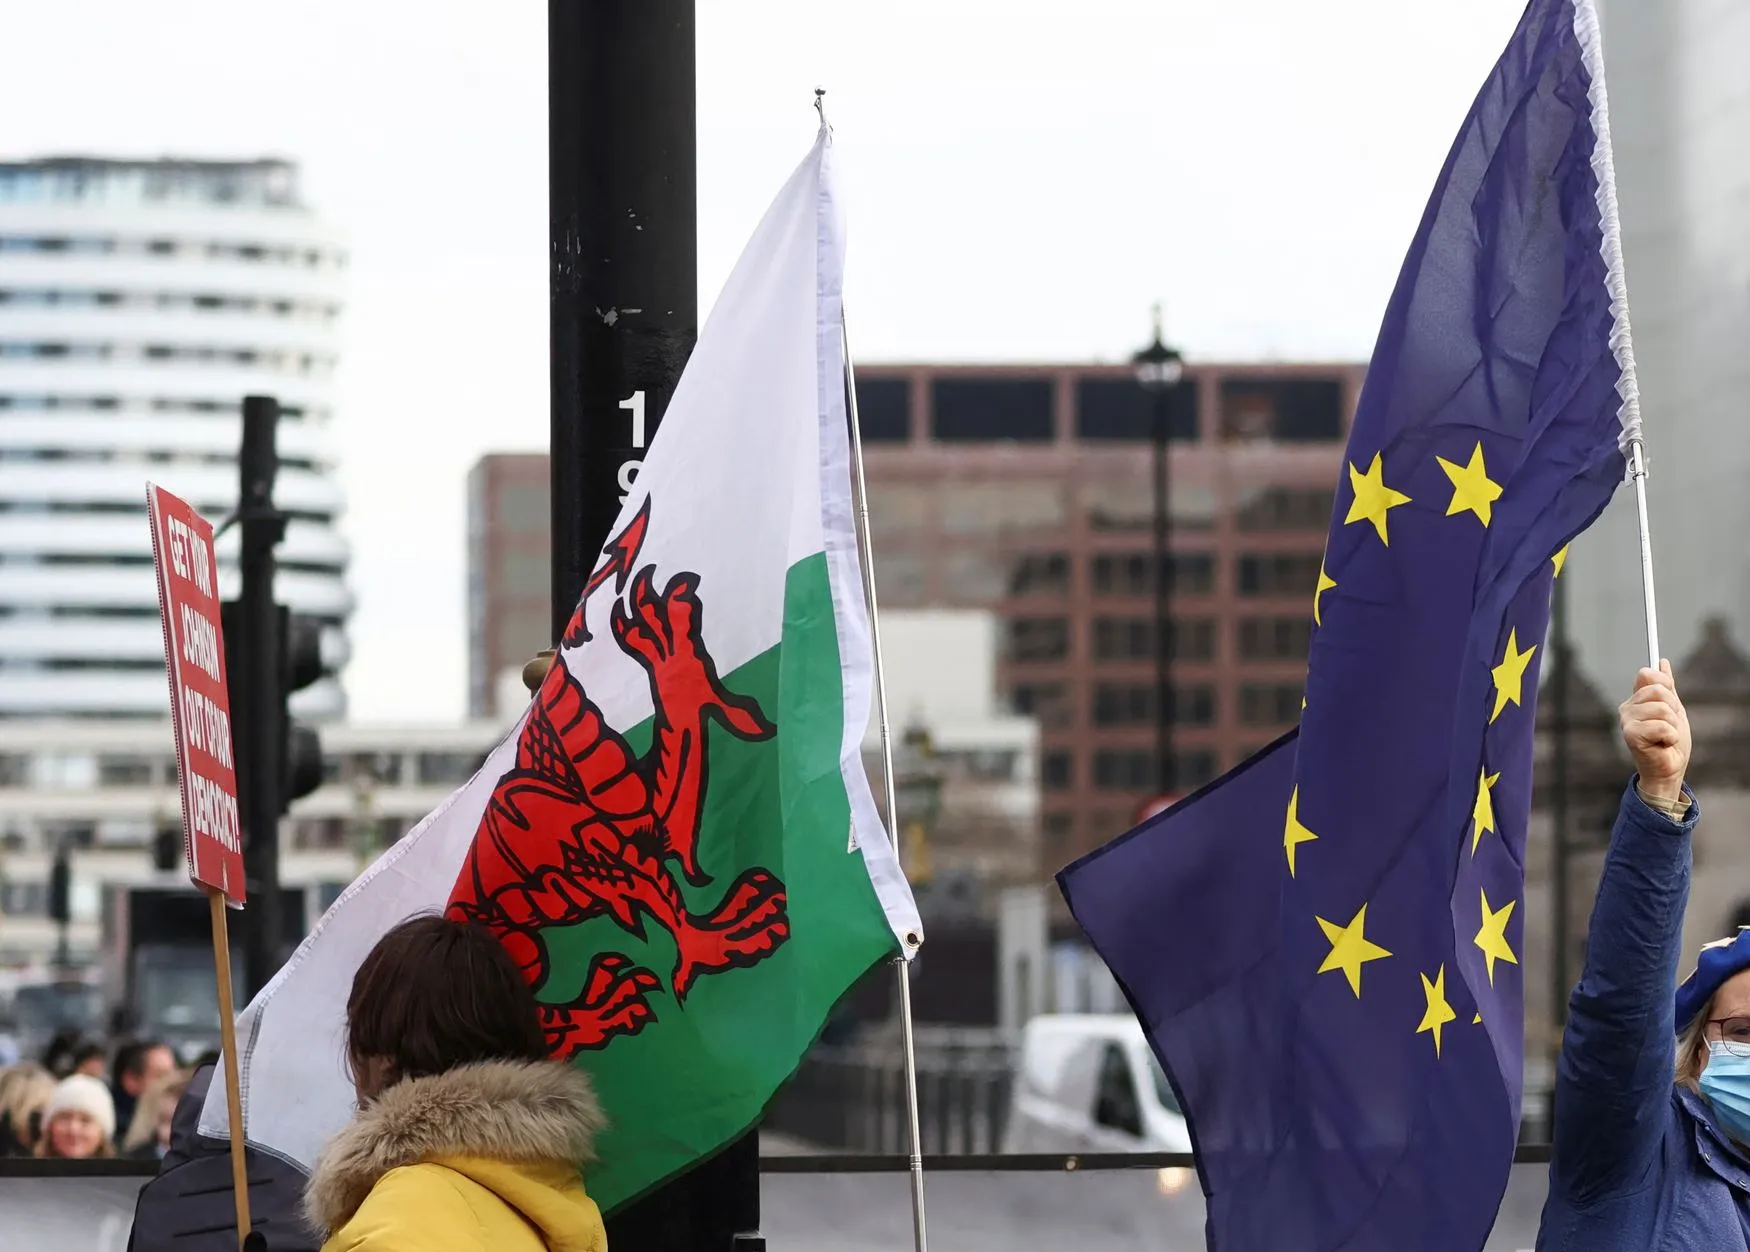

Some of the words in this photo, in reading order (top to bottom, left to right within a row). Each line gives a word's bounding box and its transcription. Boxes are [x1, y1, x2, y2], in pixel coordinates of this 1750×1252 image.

[167, 514, 192, 582] GET
[188, 526, 213, 600] YOUR
[180, 601, 221, 684] JOHNSON
[185, 684, 207, 752] OUT
[191, 770, 241, 855] DEMOCRACY!
